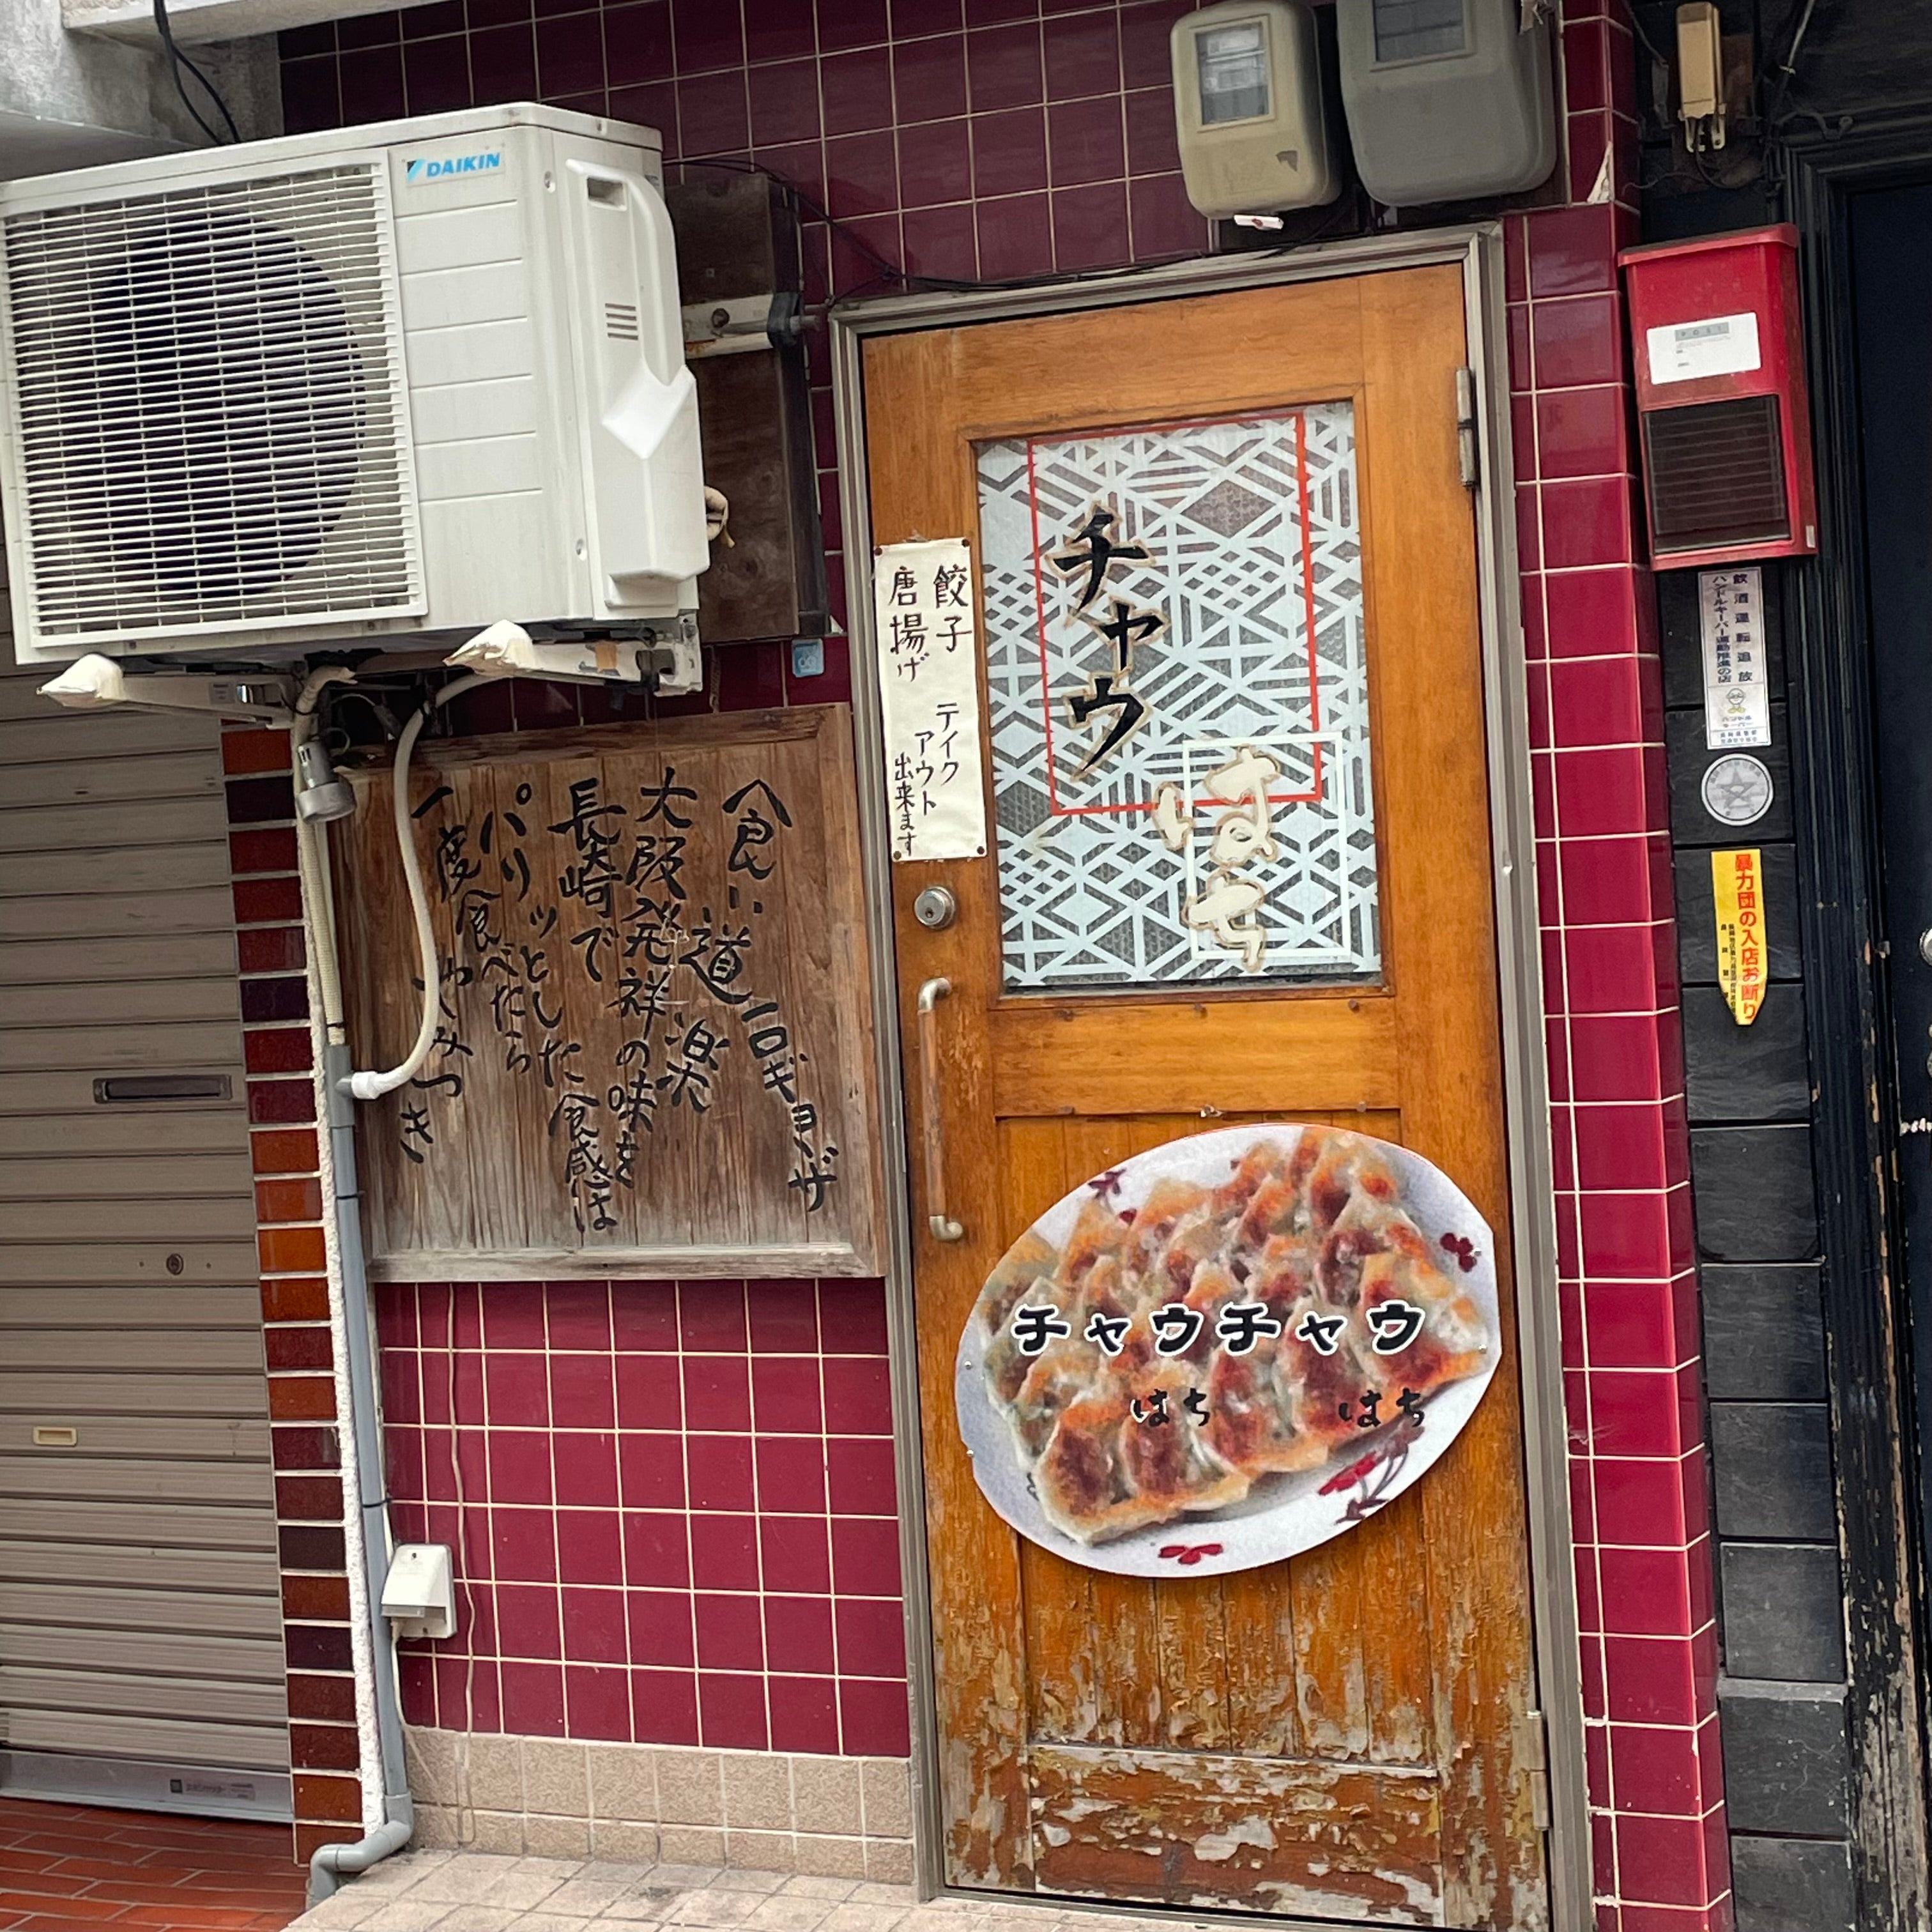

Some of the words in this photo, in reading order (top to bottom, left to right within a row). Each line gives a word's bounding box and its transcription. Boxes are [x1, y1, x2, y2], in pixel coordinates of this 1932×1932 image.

[426, 152, 500, 178] DAIKIN
[888, 565, 930, 682] 唐揚げ
[933, 564, 972, 653] 餃子
[1049, 506, 1165, 778] チャウ
[1733, 573, 1753, 682] 飲酒運転追放
[914, 730, 937, 816] アウト
[936, 702, 960, 786] テイク
[894, 751, 917, 857] 出来ます
[1153, 745, 1279, 971] はち
[547, 777, 627, 983] 長崎で
[608, 767, 698, 1190] 大阪発祥の味を
[1735, 853, 1759, 1020] 暴力団の入店お断り
[399, 956, 474, 1165] やみつき
[1009, 1300, 1427, 1357] チャウチャウ
[1130, 1388, 1210, 1429] はち
[1338, 1388, 1427, 1429] はち
